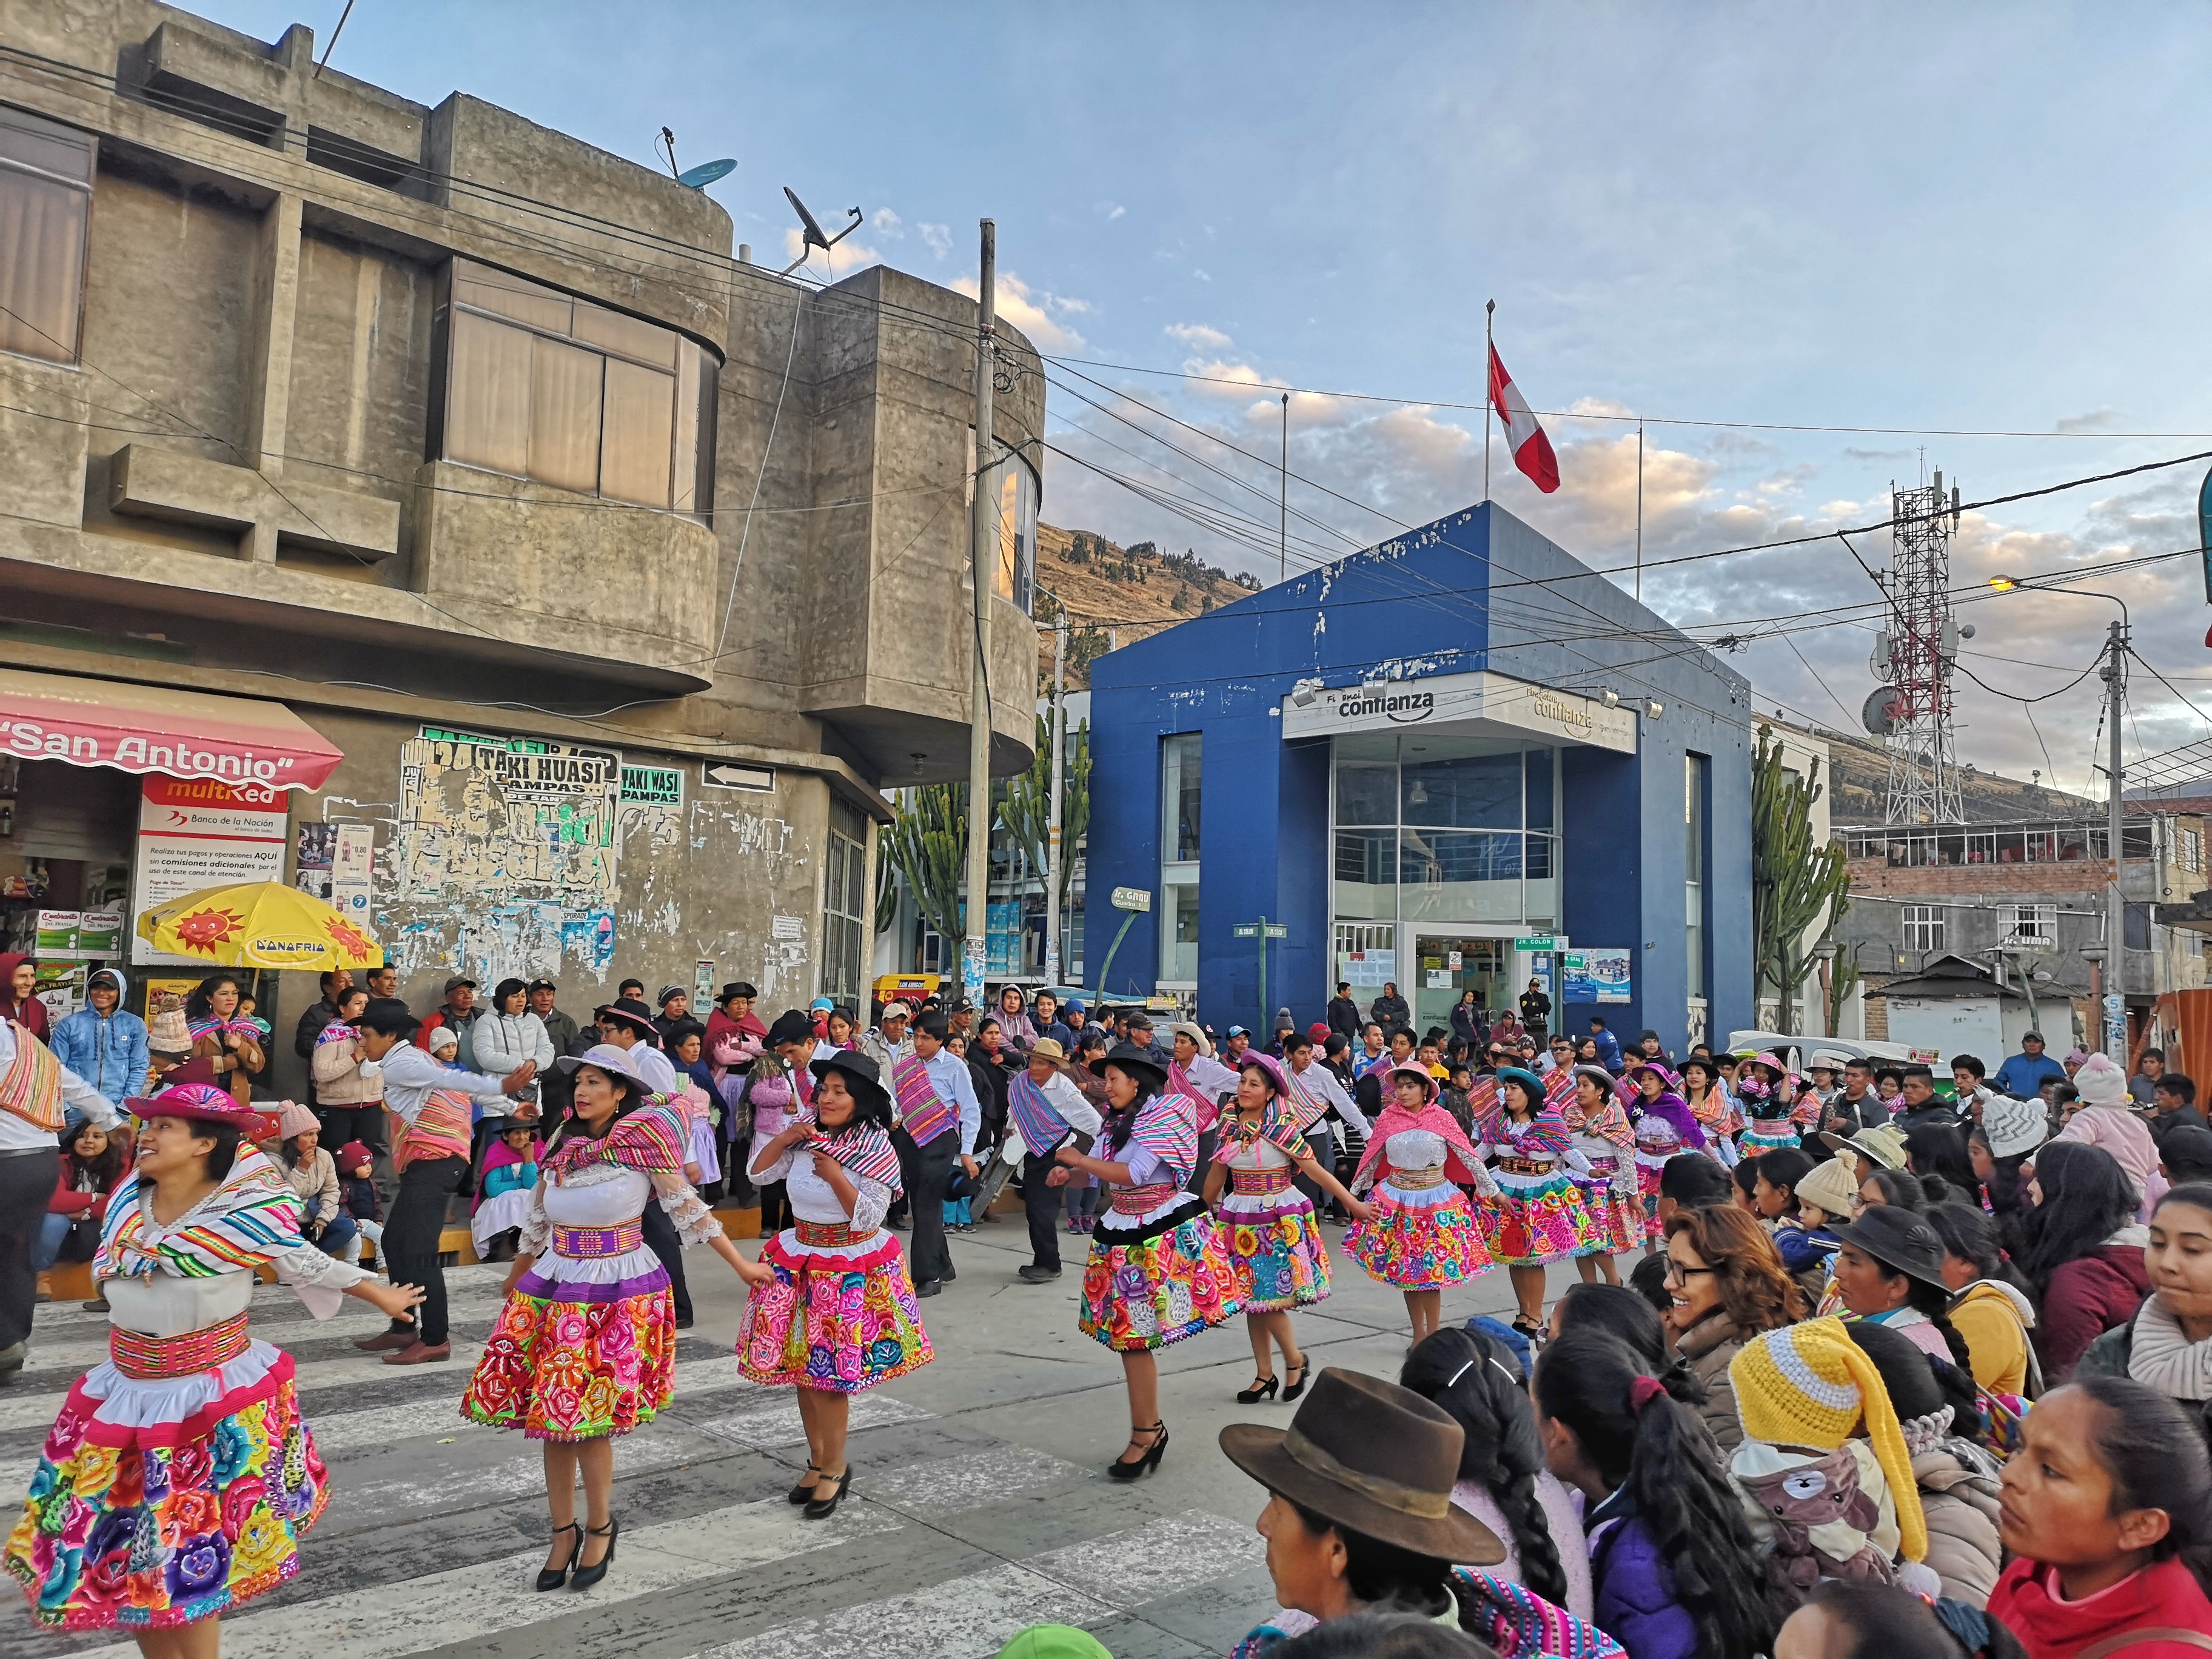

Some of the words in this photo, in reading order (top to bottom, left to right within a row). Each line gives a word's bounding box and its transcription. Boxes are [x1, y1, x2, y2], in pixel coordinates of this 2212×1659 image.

[1339, 692, 1434, 717] confianza
[1534, 700, 1592, 729] confianza
[478, 748, 529, 779] TAKI
[537, 758, 602, 784] HUASI
[622, 769, 648, 789] TAKI
[652, 771, 679, 793] WASI
[621, 789, 679, 803] PAMPAS
[192, 814, 218, 823] Banco
[243, 818, 273, 827] Nación
[254, 851, 278, 860] AQUÍ
[161, 859, 207, 867] comisiones
[209, 860, 255, 869] adicionales
[1114, 889, 1124, 898] Jr.
[1126, 891, 1149, 903] GRAU
[2021, 936, 2050, 945] LIMA
[2110, 999, 2119, 1010] 5
